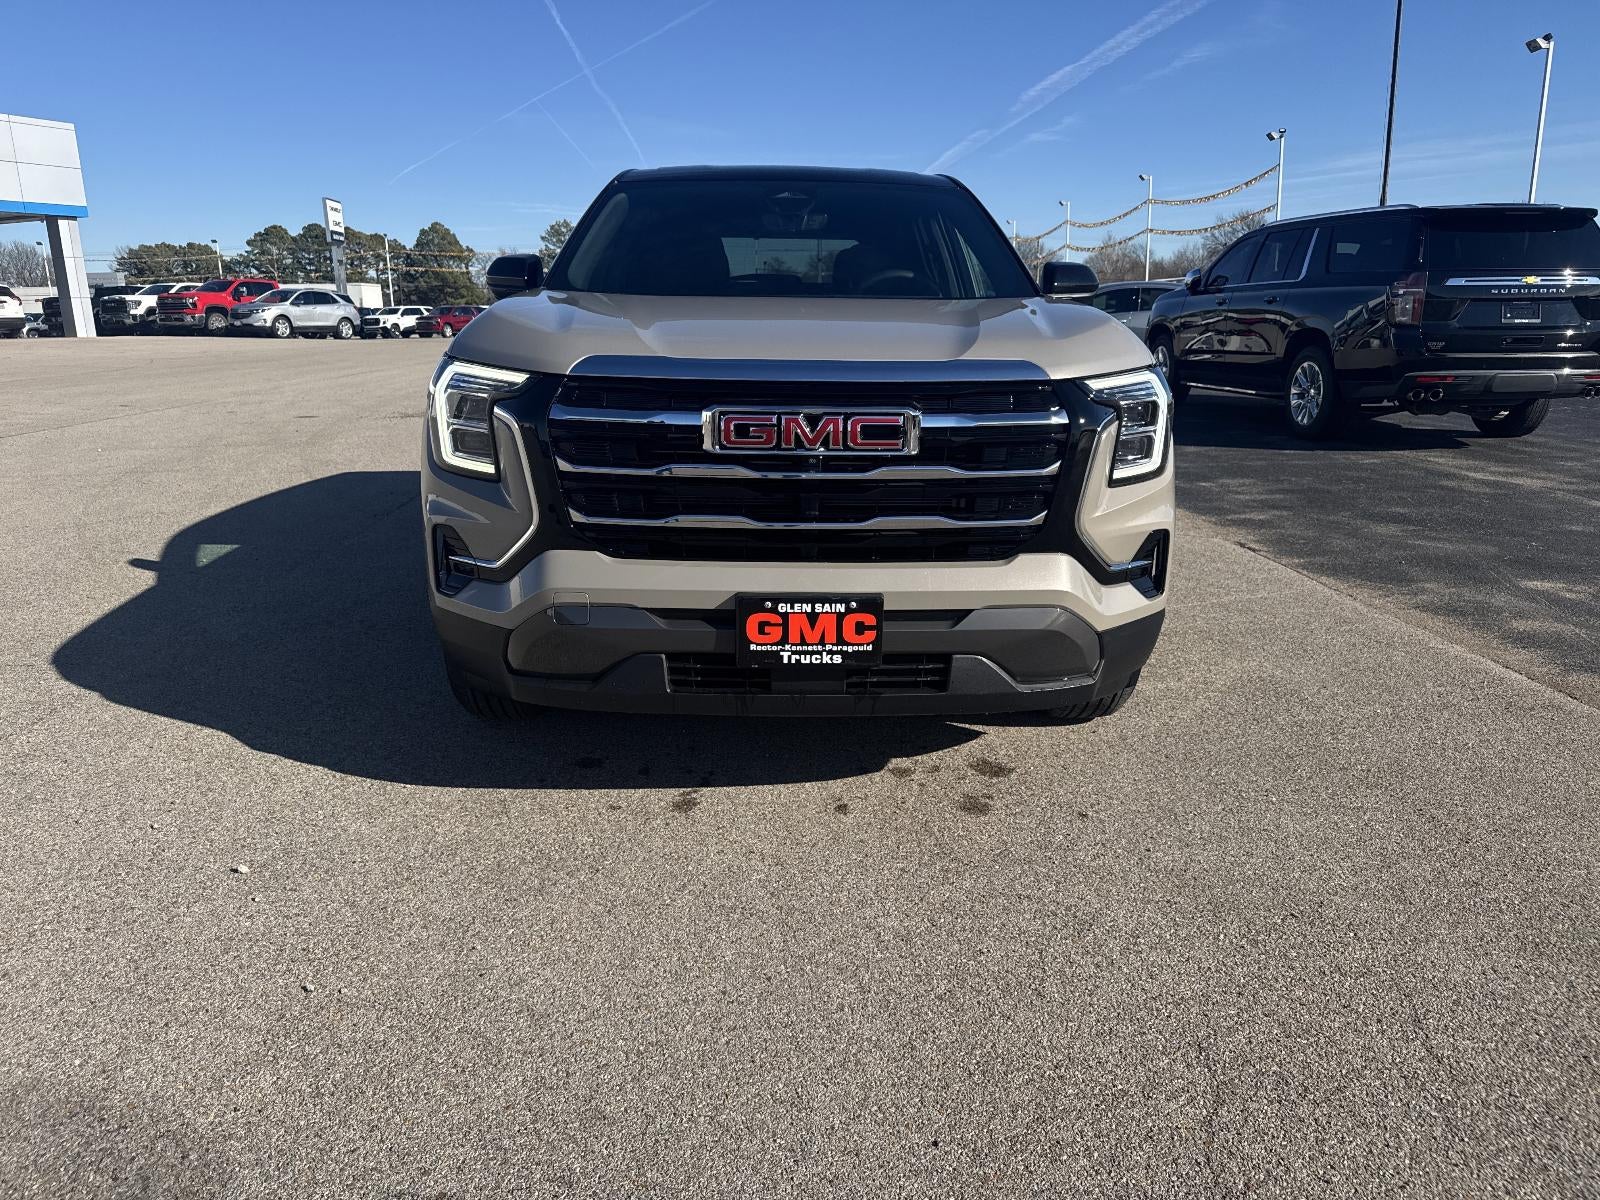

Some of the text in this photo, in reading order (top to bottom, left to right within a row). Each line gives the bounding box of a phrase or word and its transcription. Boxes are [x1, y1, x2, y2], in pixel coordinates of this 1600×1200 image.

[720, 414, 903, 449] GMC
[778, 603, 845, 613] GLEN SAIN
[746, 612, 877, 644] GMC
[750, 644, 873, 652] Rector-Kennett-Paragould
[780, 651, 842, 664] Trucks
